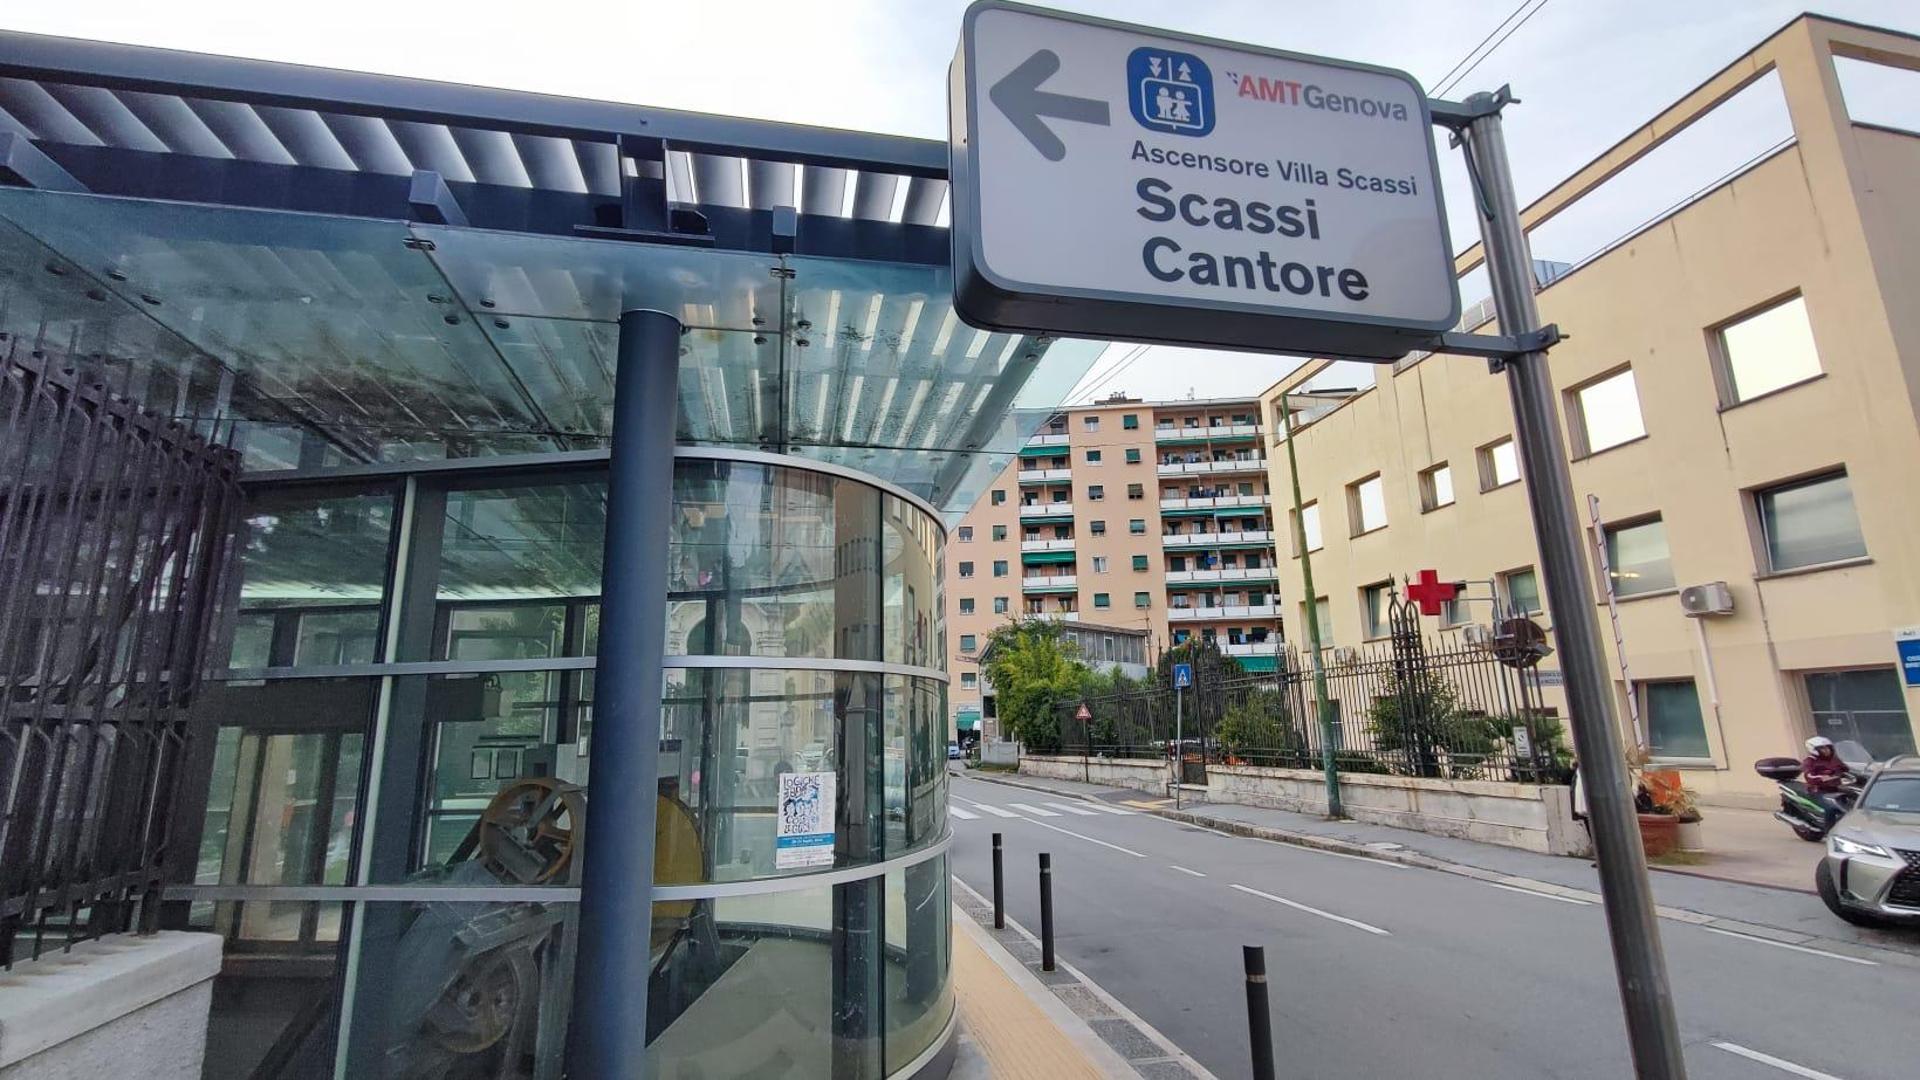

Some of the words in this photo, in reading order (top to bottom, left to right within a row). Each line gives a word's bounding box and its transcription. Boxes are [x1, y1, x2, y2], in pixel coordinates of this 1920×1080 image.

[1131, 140, 1269, 178] Ascensore
[1277, 160, 1328, 186] Villa
[1337, 168, 1417, 196] Scassi
[1136, 177, 1320, 240] Scassi
[1142, 236, 1369, 301] Cantore
